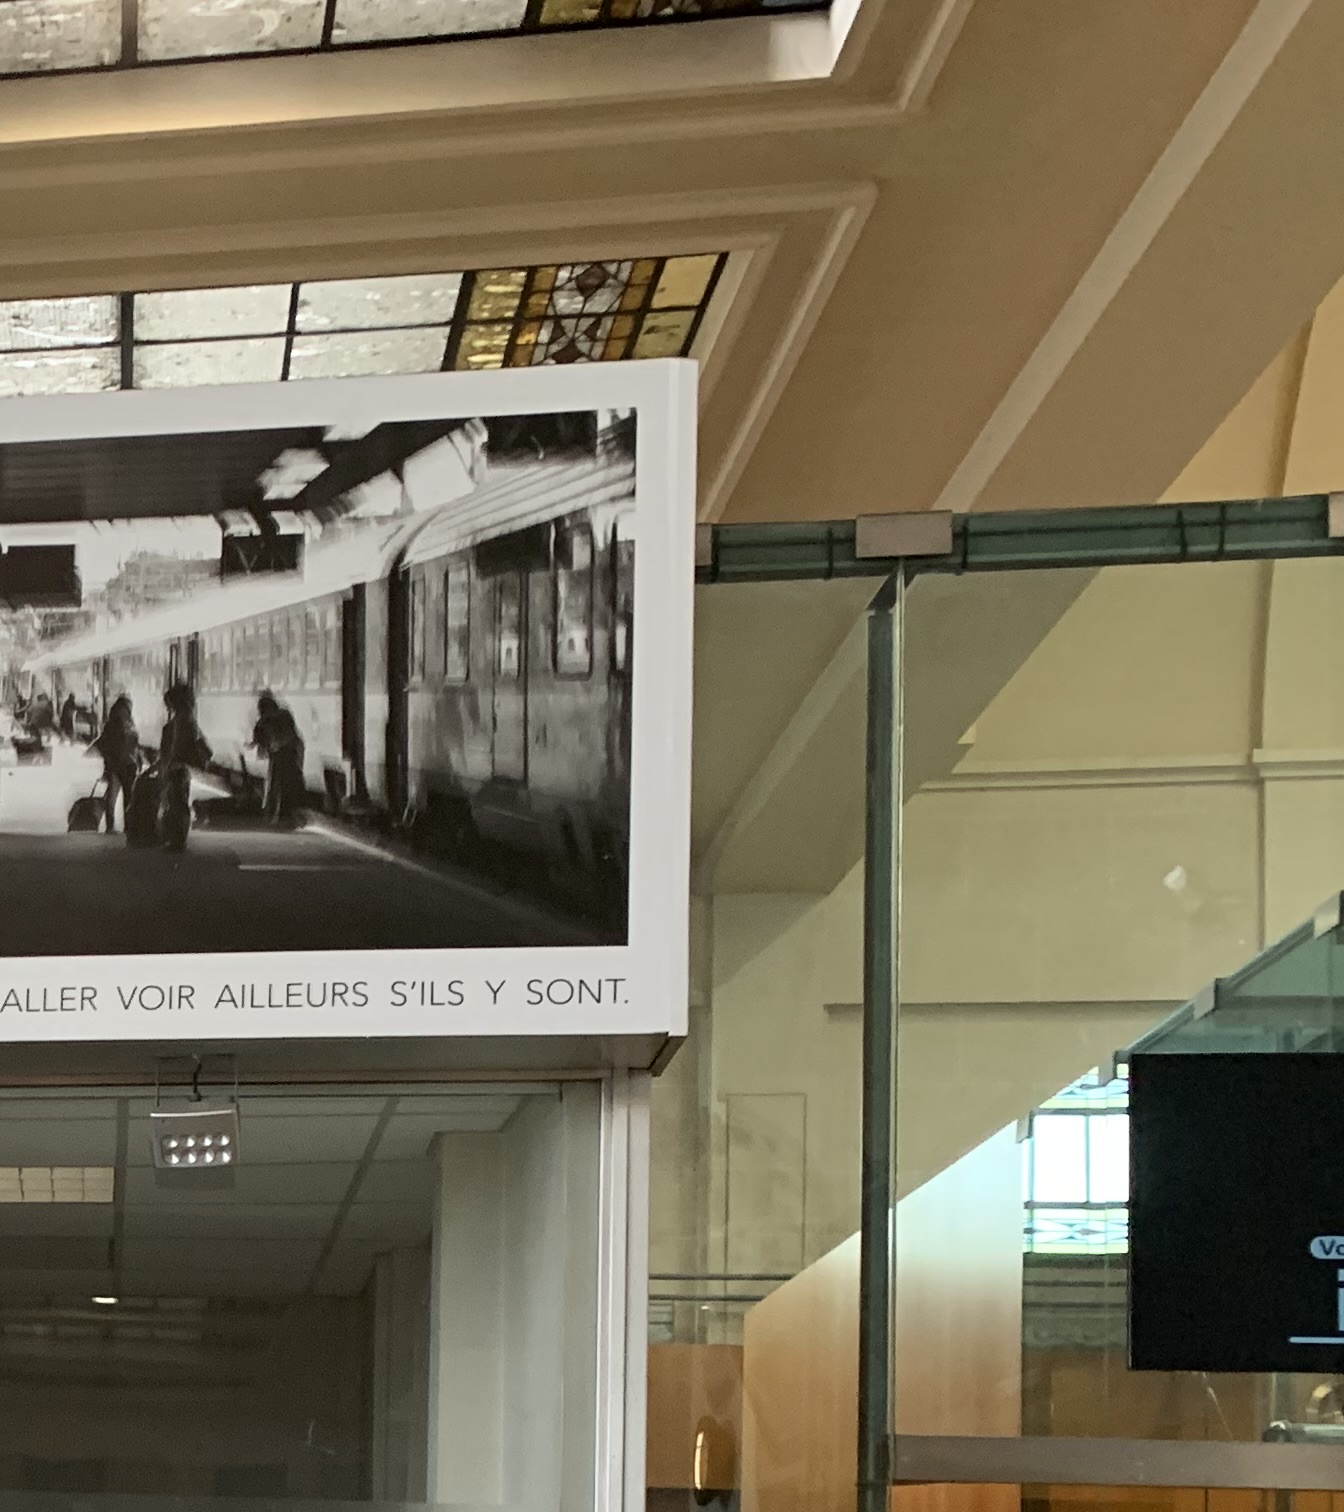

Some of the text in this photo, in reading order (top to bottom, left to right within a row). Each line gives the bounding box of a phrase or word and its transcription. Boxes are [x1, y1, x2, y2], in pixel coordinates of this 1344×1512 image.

[116, 985, 195, 1011] VOIR
[214, 981, 369, 1009] AILLEURS
[390, 980, 464, 1007] S'ILS
[485, 980, 506, 1005] Y
[526, 978, 629, 1005] SONT.
